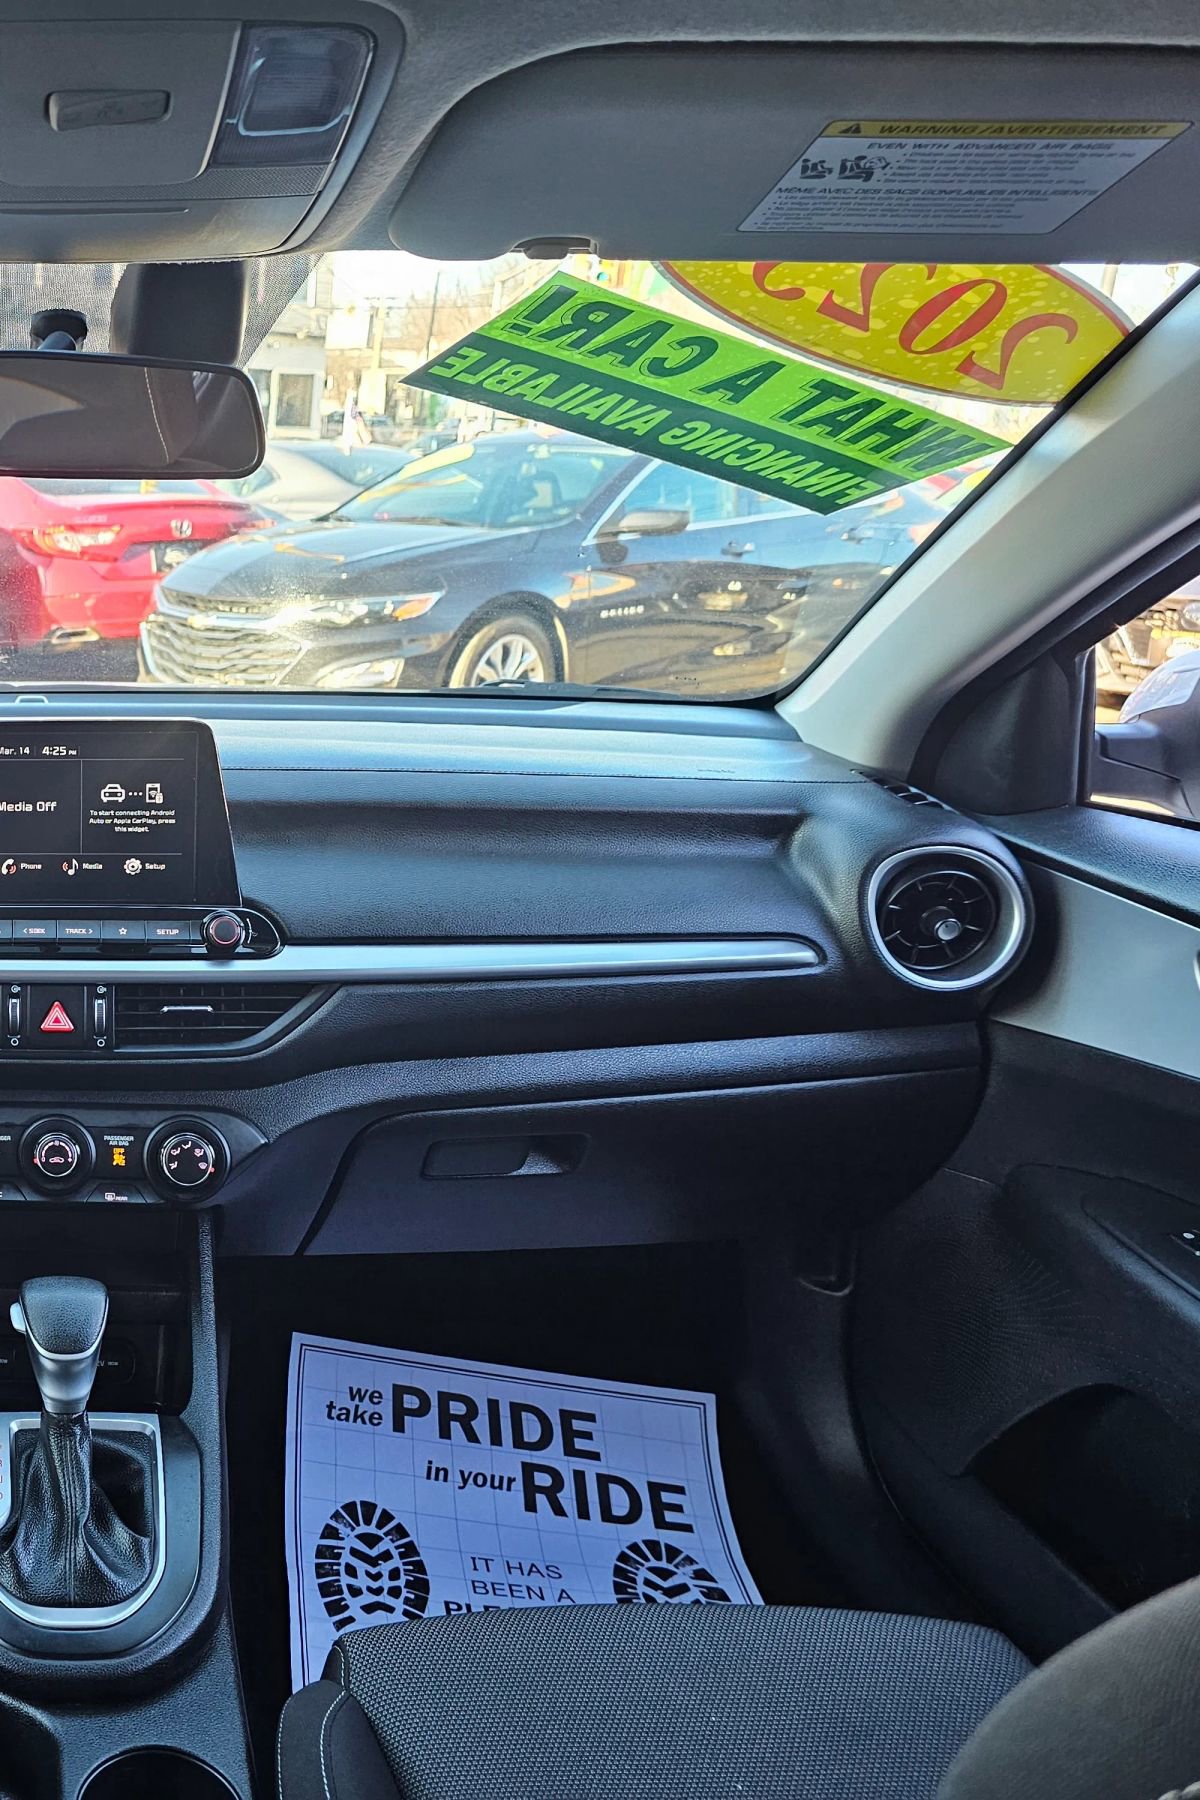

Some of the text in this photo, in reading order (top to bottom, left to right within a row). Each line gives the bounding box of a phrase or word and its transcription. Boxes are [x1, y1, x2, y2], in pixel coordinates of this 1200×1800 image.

[19, 747, 30, 755] 14
[41, 746, 67, 756] 4:25
[36, 801, 57, 812] Off
[115, 810, 150, 818] connecting
[145, 863, 166, 871] Setup
[348, 1385, 384, 1406] we
[325, 1400, 384, 1427] take
[391, 1383, 602, 1462] PRIDE
[425, 1460, 695, 1534] in your RIDE
[470, 1556, 563, 1580] IT HAS
[470, 1579, 577, 1604] BEEN A
